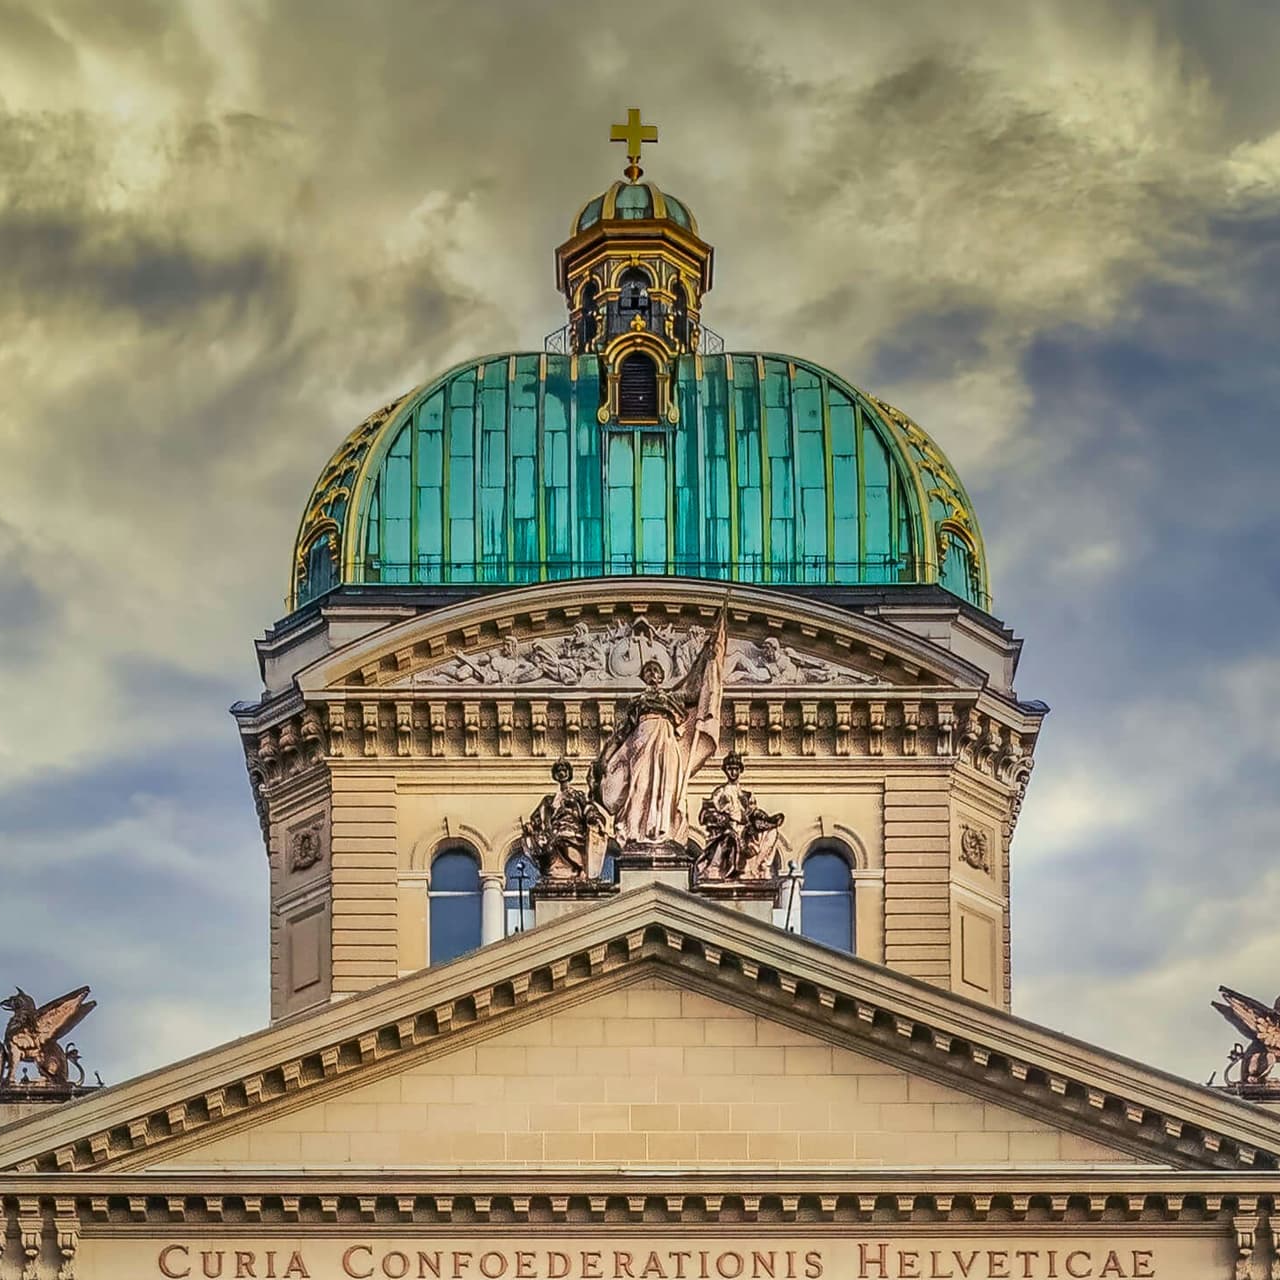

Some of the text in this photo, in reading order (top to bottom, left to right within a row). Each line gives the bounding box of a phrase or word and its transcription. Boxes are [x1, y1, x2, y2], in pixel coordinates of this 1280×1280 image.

[158, 1243, 1156, 1279] CURIA CONFOEDERATIONIS HELVETICAE
